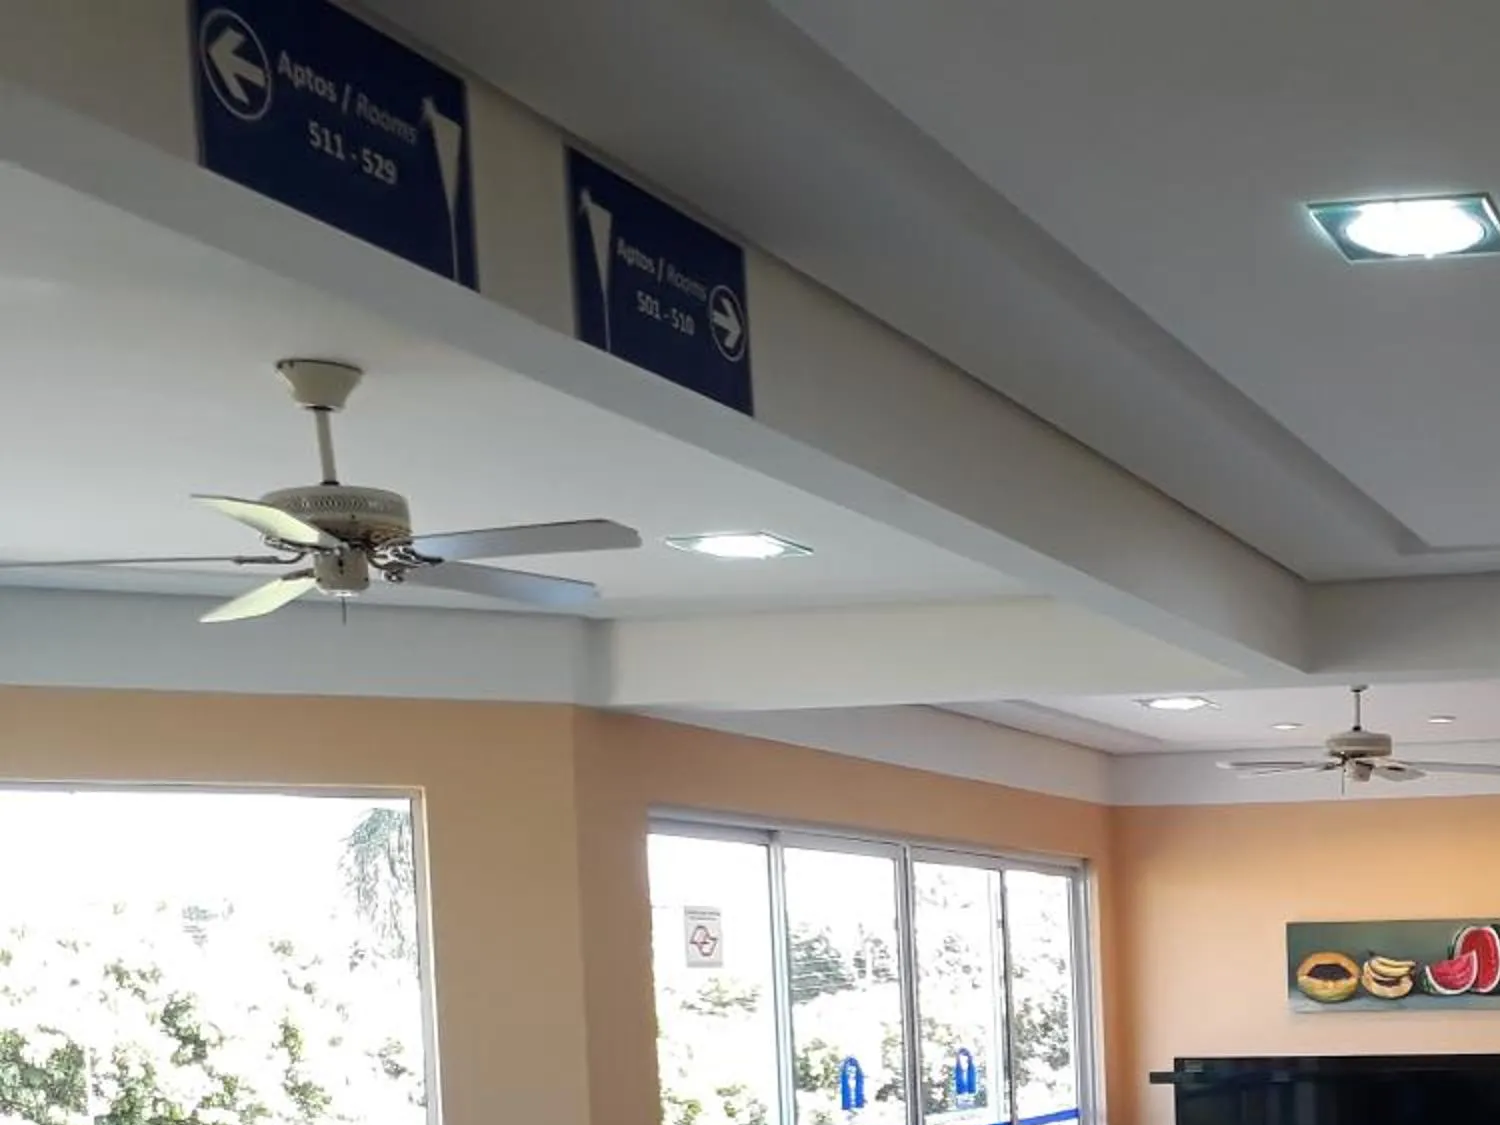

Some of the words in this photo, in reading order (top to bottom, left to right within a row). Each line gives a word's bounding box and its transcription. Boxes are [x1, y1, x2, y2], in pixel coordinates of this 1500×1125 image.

[277, 49, 337, 103] Aptos
[341, 82, 352, 115] /
[355, 92, 419, 146] Rooms
[308, 119, 345, 161] 511
[361, 147, 398, 185] 529
[616, 236, 656, 274] Aptos
